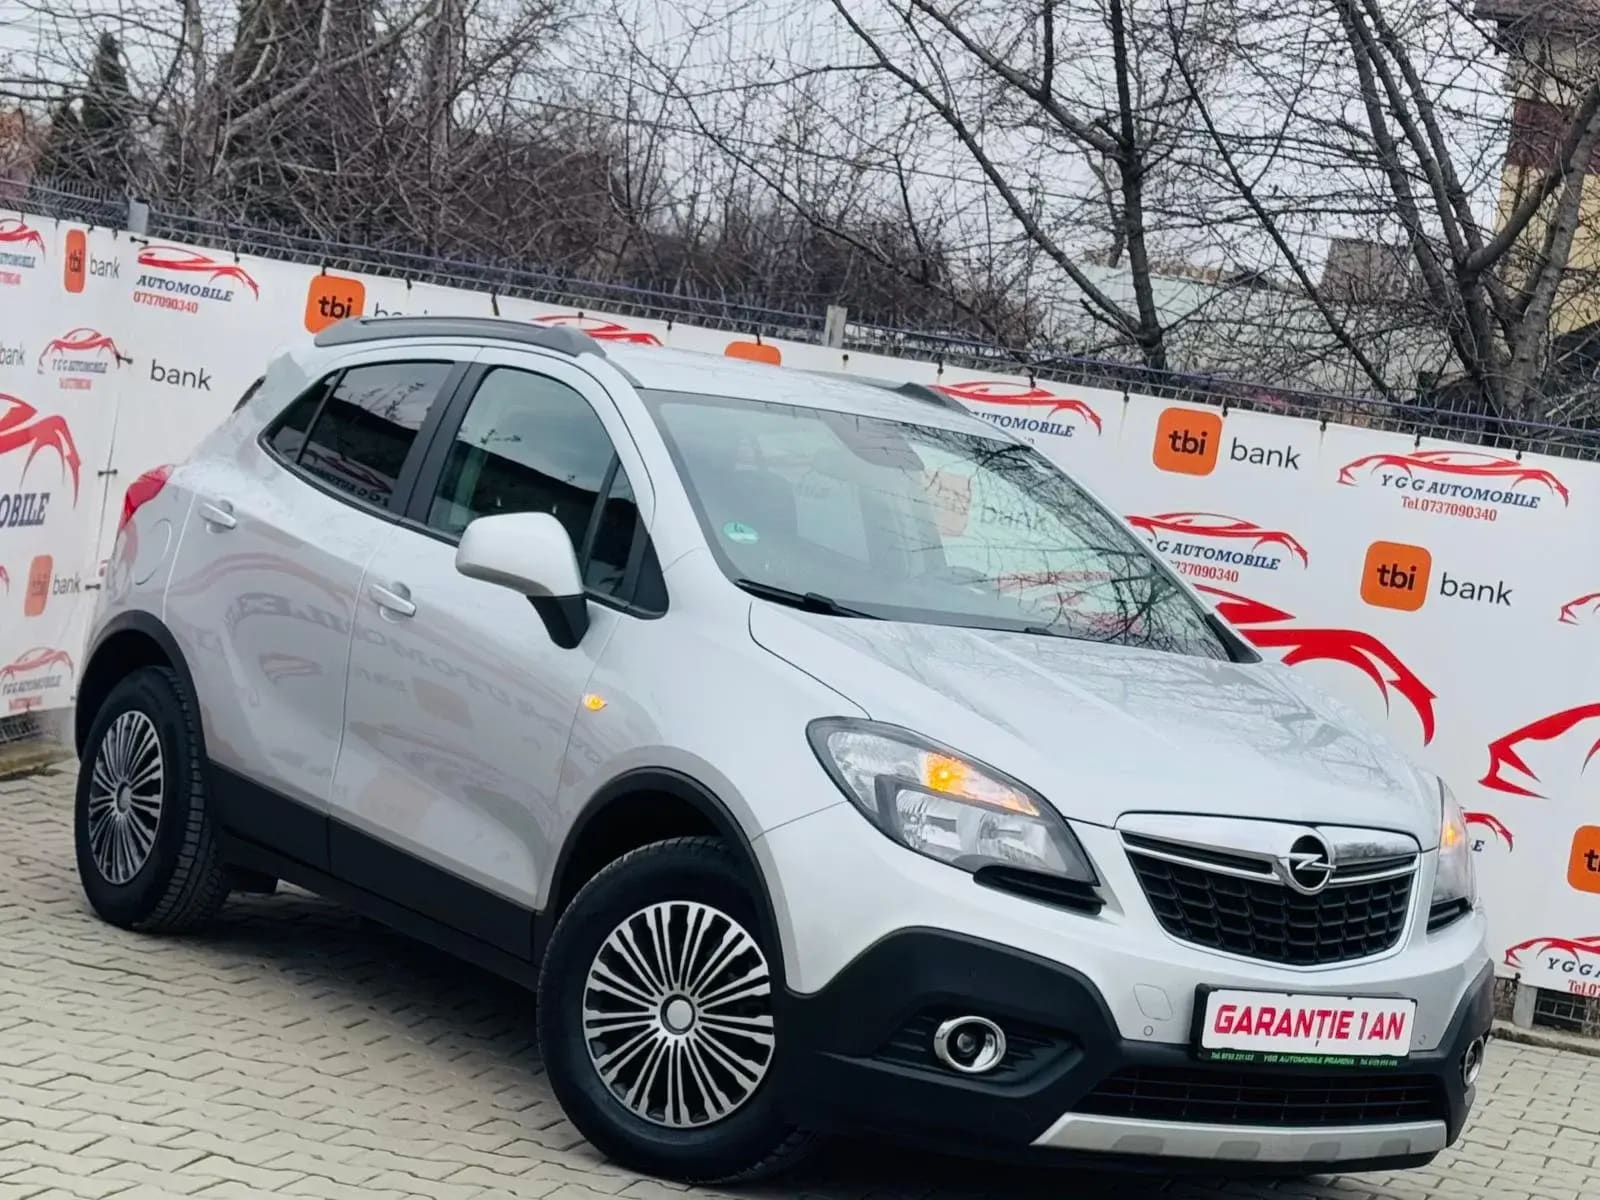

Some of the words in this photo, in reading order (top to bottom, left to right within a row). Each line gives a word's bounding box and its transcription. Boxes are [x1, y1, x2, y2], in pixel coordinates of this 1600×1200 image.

[90, 252, 120, 279] bank
[133, 291, 199, 314] 0737090340
[136, 275, 235, 302] AUTOMOBILE
[318, 295, 353, 319] tbi
[150, 358, 212, 391] bank
[1168, 429, 1208, 456] tbi
[1230, 436, 1301, 471] bank
[1426, 481, 1541, 509] AUTOMOBILE
[1170, 542, 1281, 570] AUTOMOBILE
[1376, 563, 1417, 591] tbi
[1439, 571, 1513, 607] bank
[1357, 1011, 1369, 1041] 1
[1367, 1011, 1407, 1041] AN
